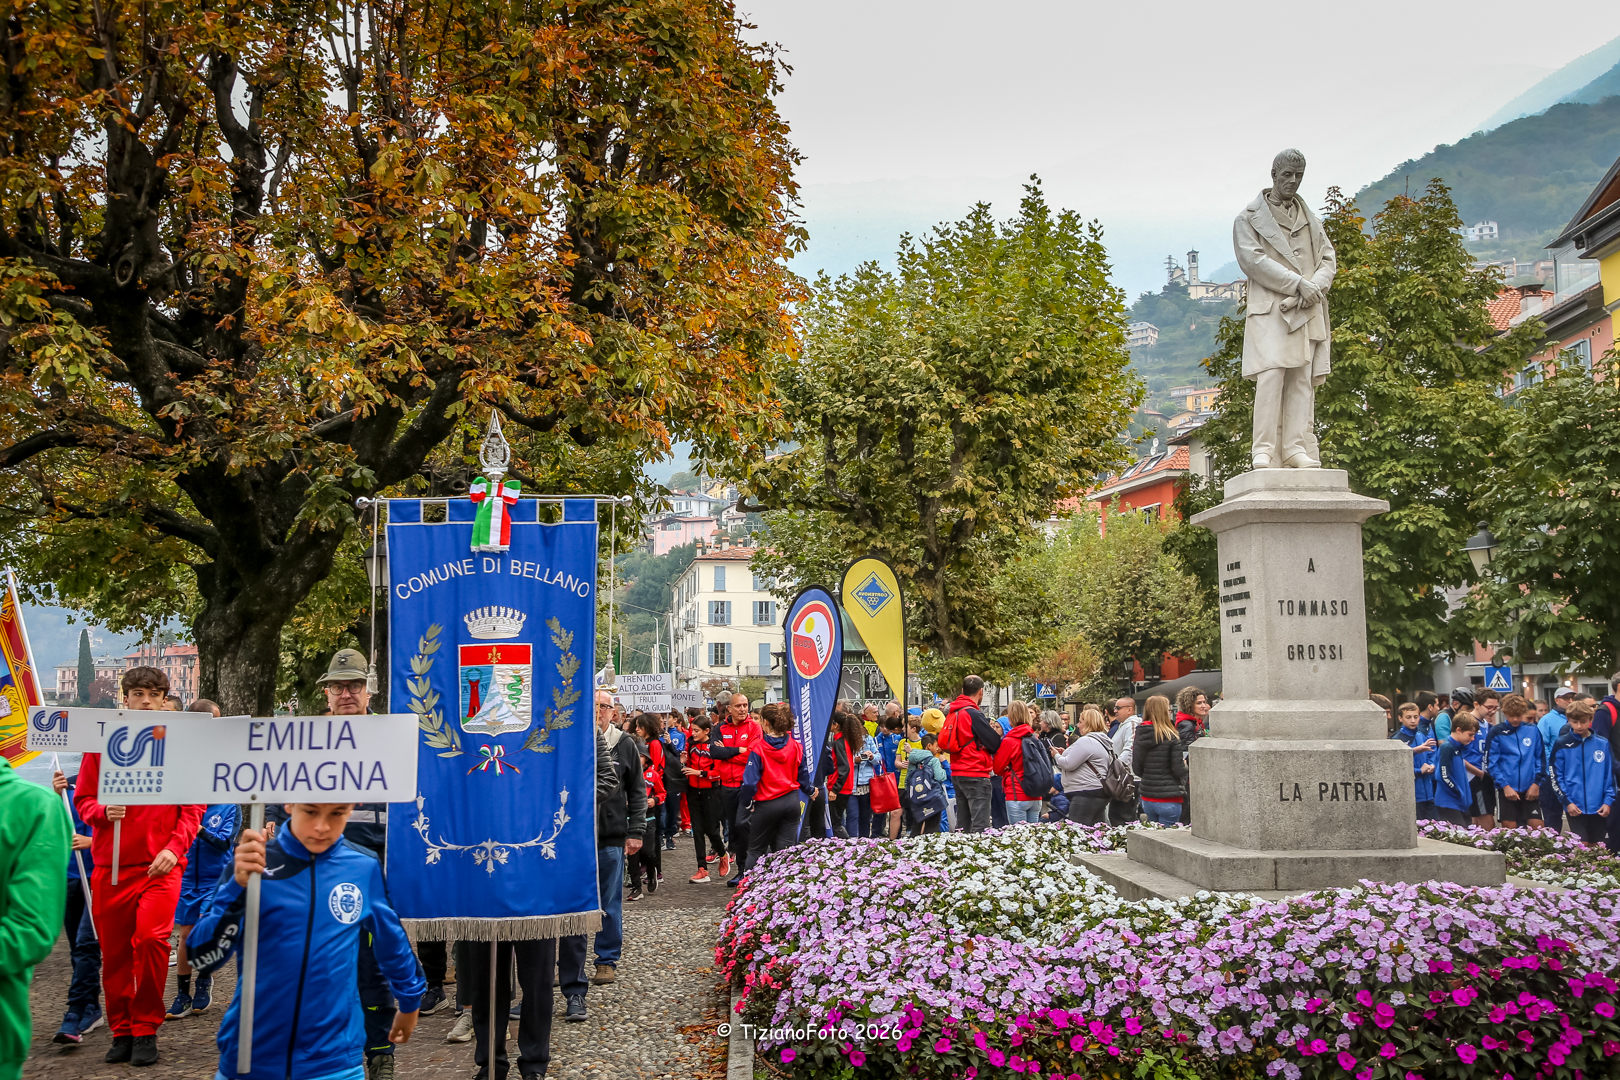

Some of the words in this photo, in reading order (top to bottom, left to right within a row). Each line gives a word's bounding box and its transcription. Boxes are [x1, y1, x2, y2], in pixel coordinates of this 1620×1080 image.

[1307, 557, 1316, 573] A
[395, 557, 476, 600] COMUNE
[482, 557, 501, 574] DI
[510, 559, 590, 598] BELLANO
[1278, 599, 1349, 616] TOMMASO
[1287, 644, 1343, 661] GROSSI
[622, 675, 662, 683] TRENTINO
[671, 693, 696, 702] MONTE
[651, 704, 671, 712] GIULIA
[247, 719, 357, 751] EMILIA
[212, 761, 388, 793] ROMAGNA
[1279, 782, 1302, 802] LA
[1318, 781, 1387, 802] PATRIA
